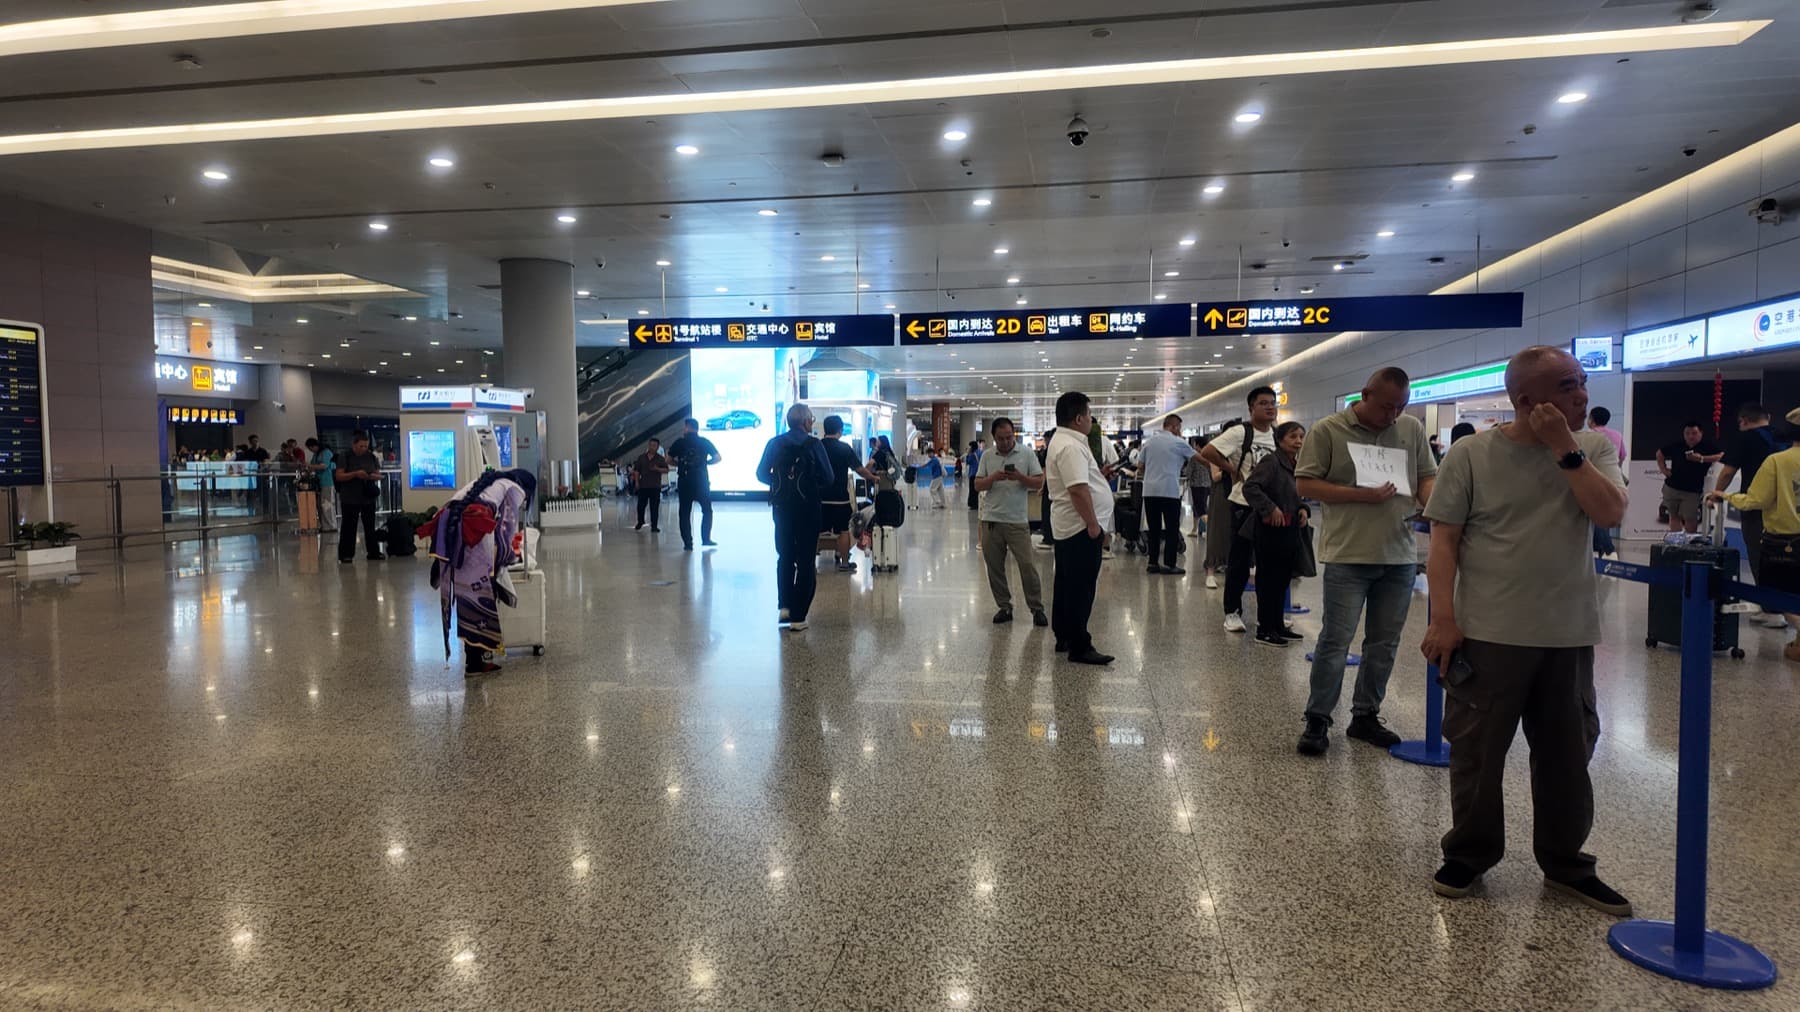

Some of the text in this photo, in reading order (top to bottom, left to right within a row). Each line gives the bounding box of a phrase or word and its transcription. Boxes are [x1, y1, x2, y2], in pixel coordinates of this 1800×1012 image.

[1109, 312, 1146, 325] 网约车
[1248, 306, 1300, 320] 国内到达
[1303, 307, 1330, 324] 2C
[947, 317, 993, 331] 国内到达
[996, 318, 1021, 334] 2D
[1047, 314, 1082, 327] 出租车
[673, 324, 722, 336] 1号航站楼
[746, 323, 789, 335] 交通中心
[814, 322, 836, 334] 宾馆
[213, 368, 238, 385] 宾馆
